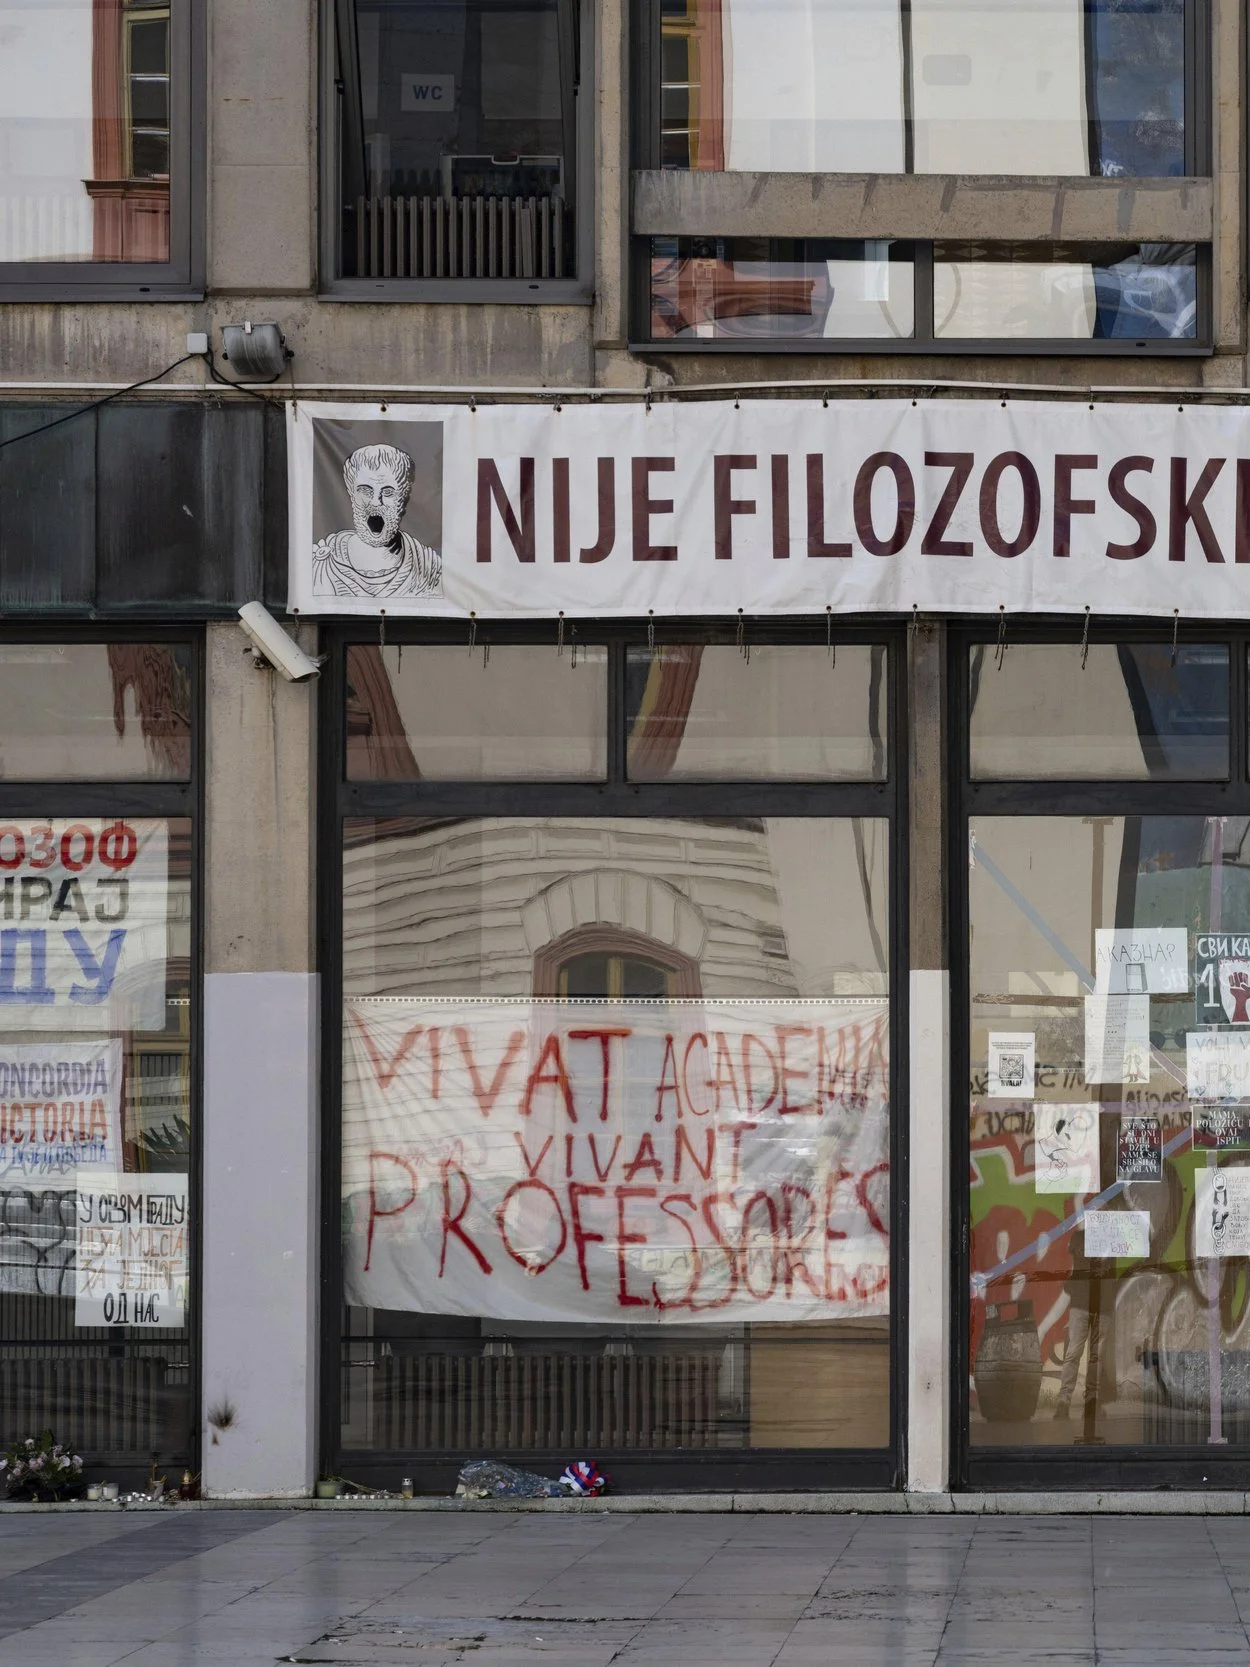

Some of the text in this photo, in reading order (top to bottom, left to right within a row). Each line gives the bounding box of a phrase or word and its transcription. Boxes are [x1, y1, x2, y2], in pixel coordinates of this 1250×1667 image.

[413, 85, 442, 100] WC
[476, 456, 678, 564] NIJE
[1197, 937, 1228, 958] СВИ
[350, 1007, 632, 1123] VIVAT
[1215, 1128, 1238, 1137] OVAJ
[1216, 1136, 1241, 1145] ISPIT
[514, 1122, 757, 1184] VIVANT
[80, 1194, 185, 1225] У ОВОМ ГРАДУ
[79, 1226, 183, 1256] НЕМА МЈЕСТА
[80, 1259, 182, 1297] ЗА ЈЕДНОГ
[104, 1292, 160, 1323] ОД НАС
